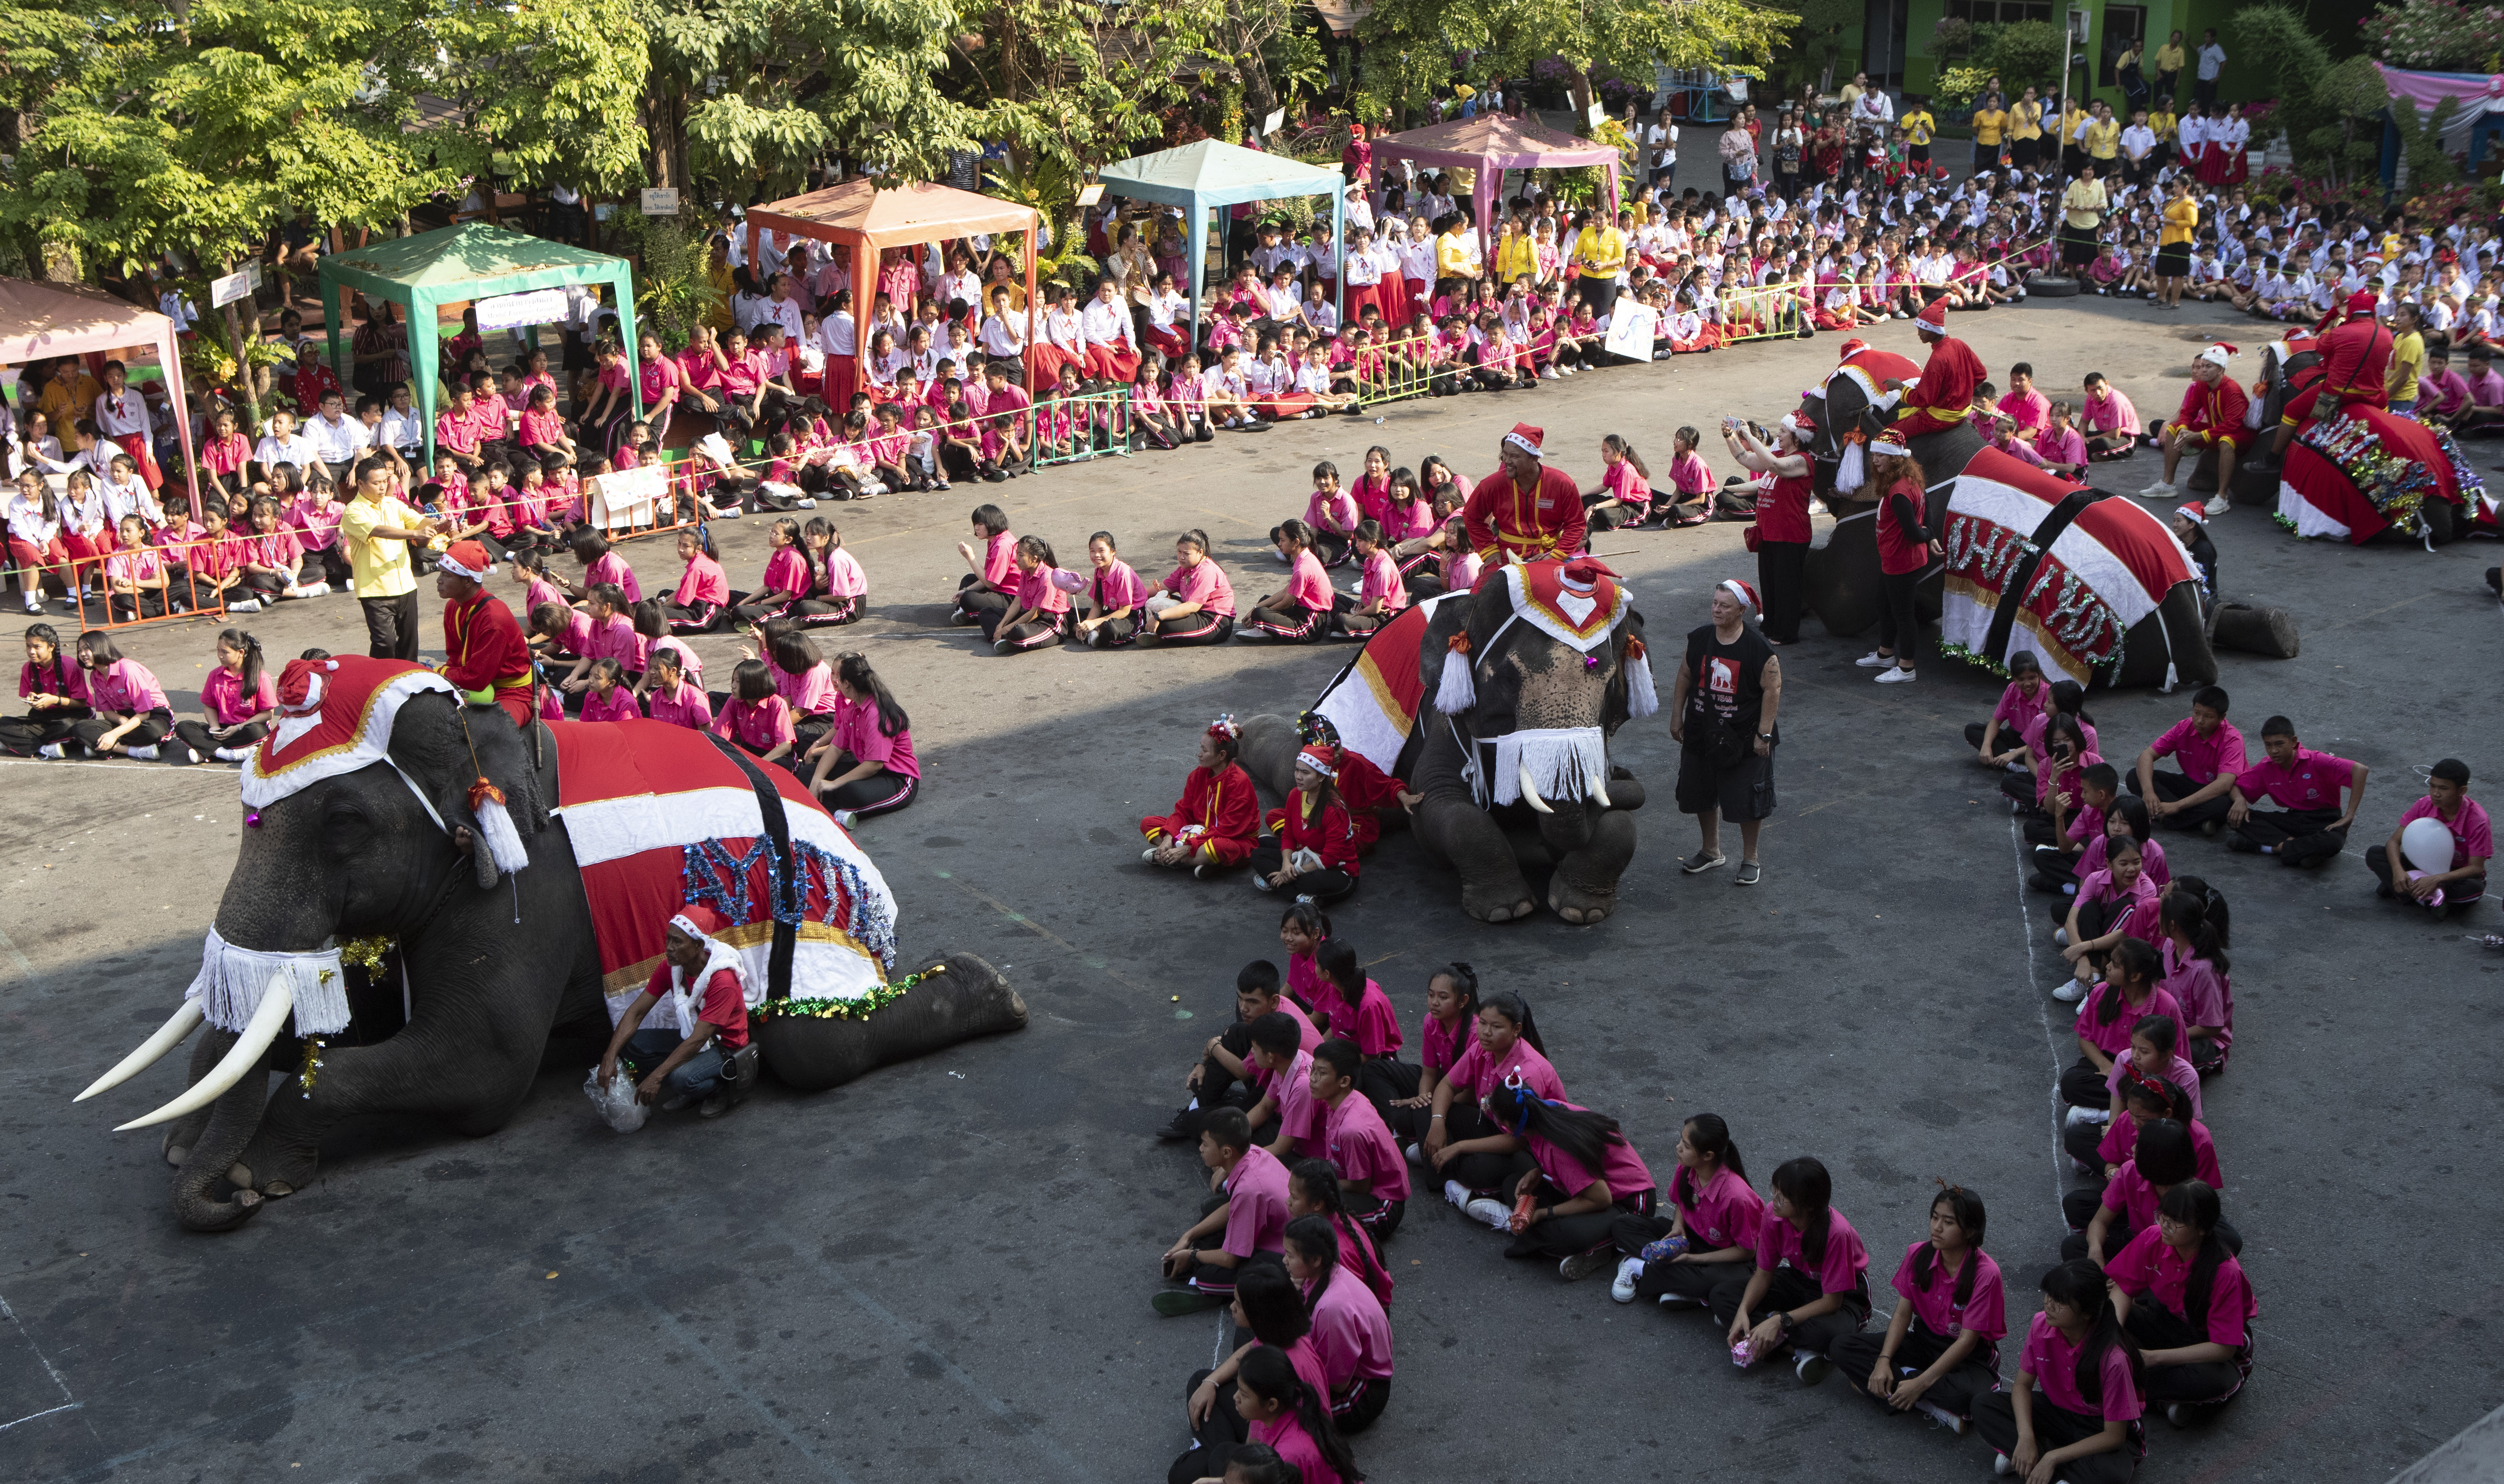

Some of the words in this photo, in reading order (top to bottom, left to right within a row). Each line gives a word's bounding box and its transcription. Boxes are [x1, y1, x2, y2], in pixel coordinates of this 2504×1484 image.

[487, 310, 506, 319] Mental
[509, 308, 534, 316] Exercises
[536, 304, 558, 313] Ground
[1717, 694, 1733, 703] TEAM
